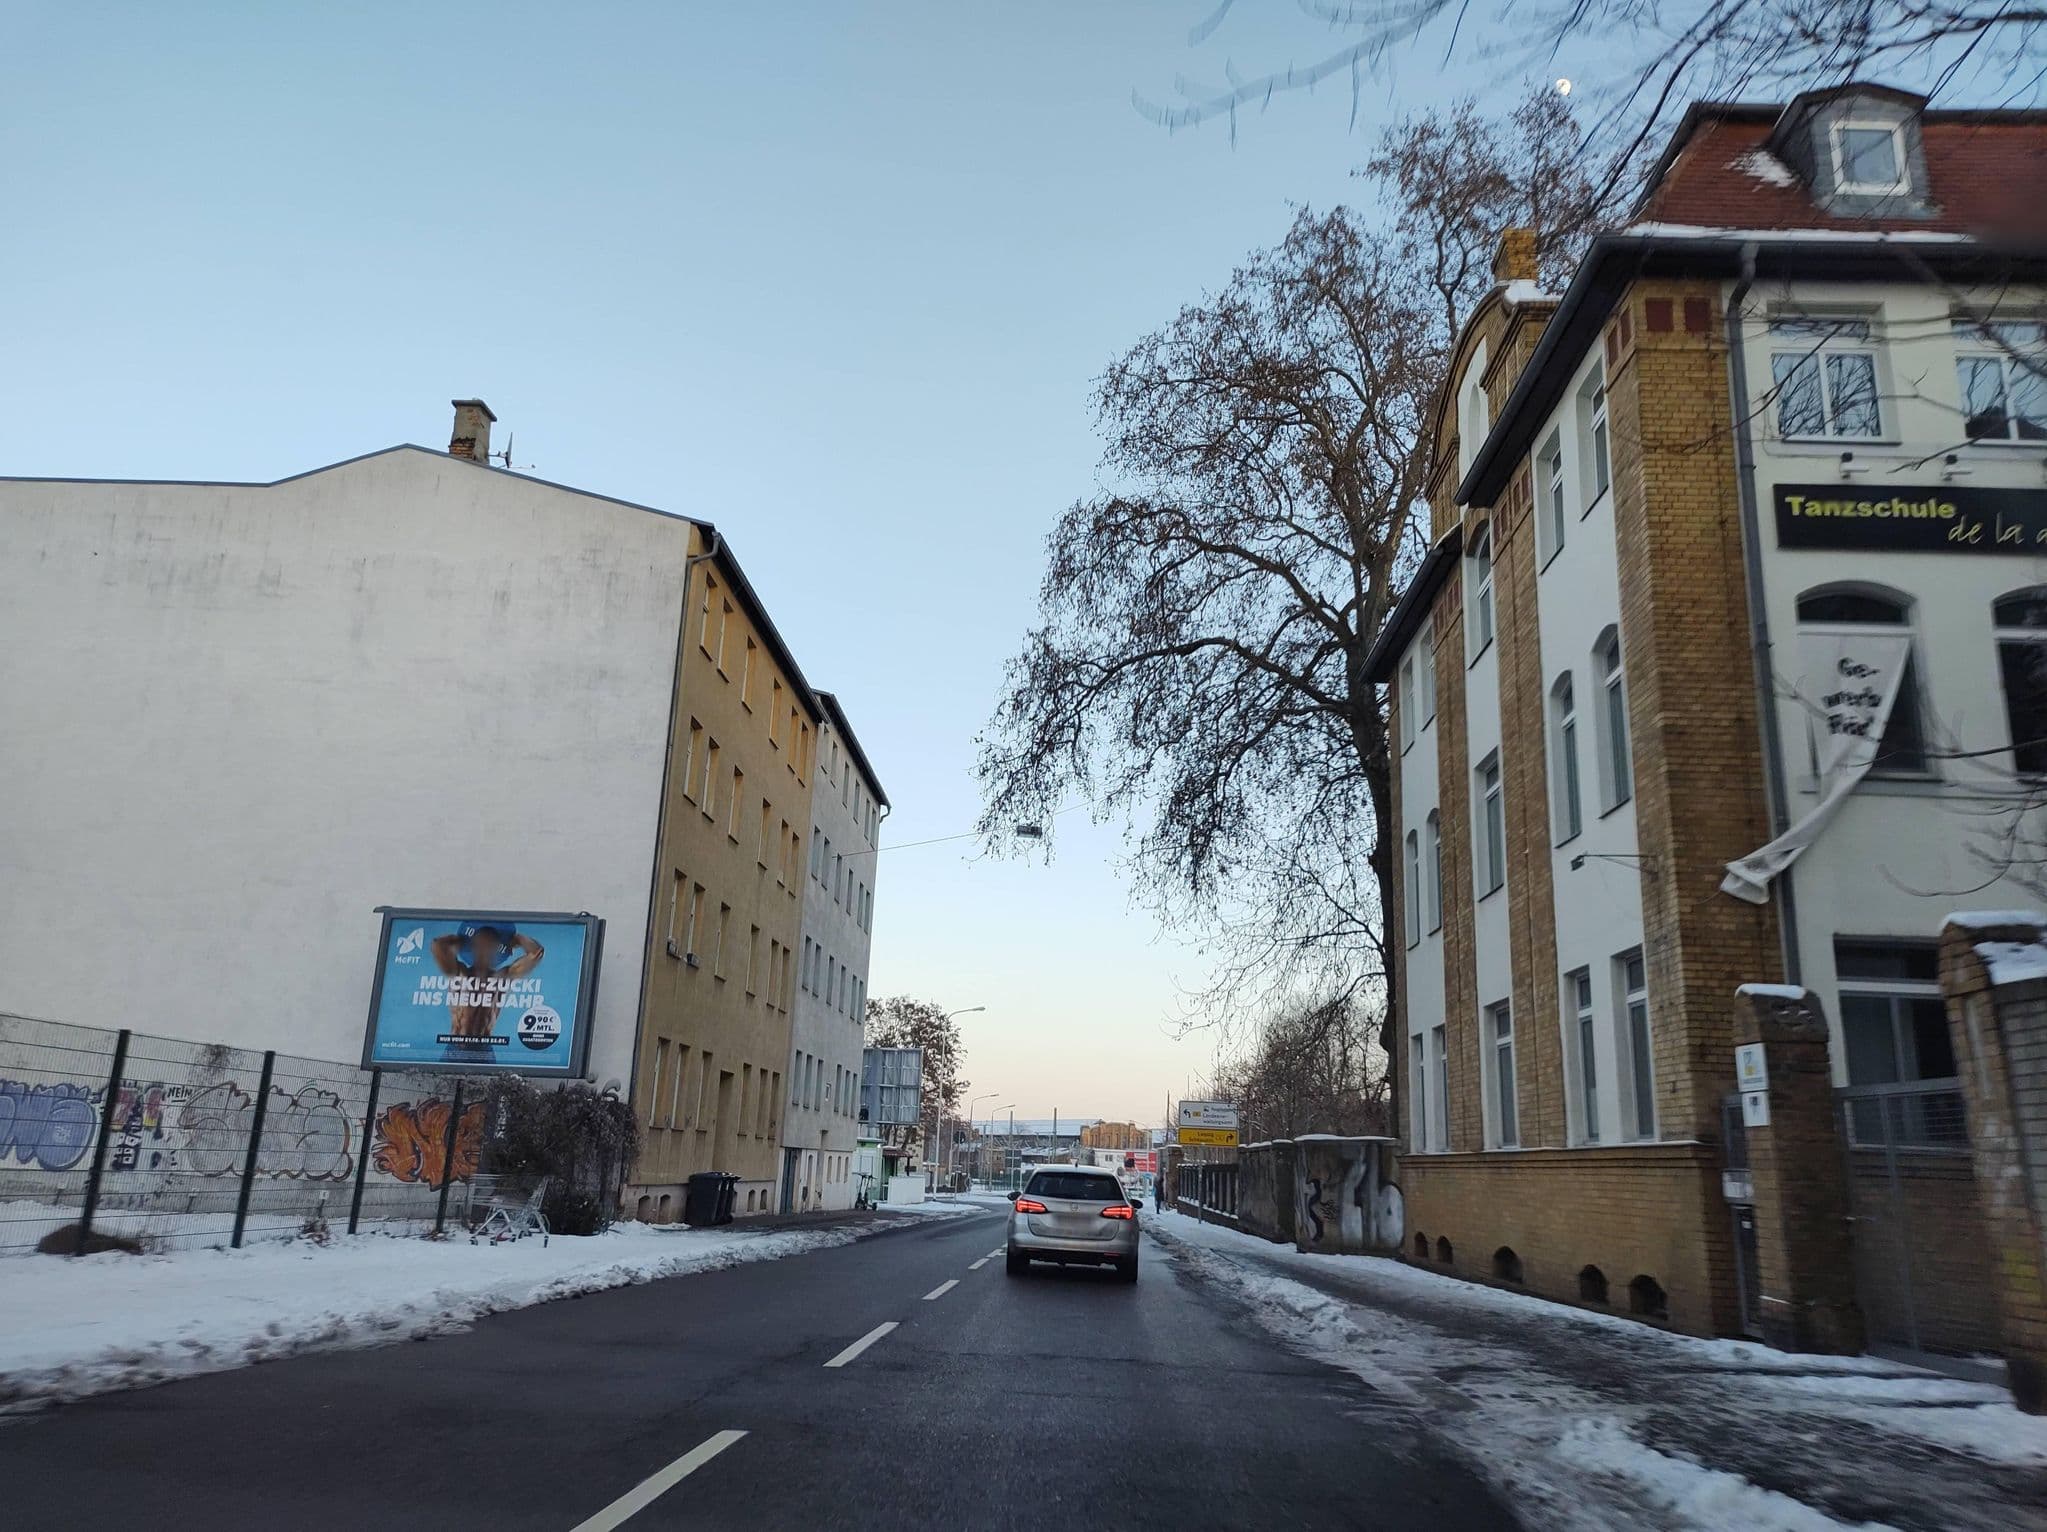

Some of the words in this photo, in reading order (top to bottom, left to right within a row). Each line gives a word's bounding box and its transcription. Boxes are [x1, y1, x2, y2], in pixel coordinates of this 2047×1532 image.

[1785, 496, 1957, 518] Tanzschule
[1948, 513, 1984, 545] de
[1995, 511, 2025, 545] la
[395, 955, 421, 965] McFIT
[420, 975, 542, 993] MUCKI-ZUCKI
[412, 991, 443, 1007] INS
[446, 991, 495, 1008] NEUE
[496, 993, 545, 1010] JAHR
